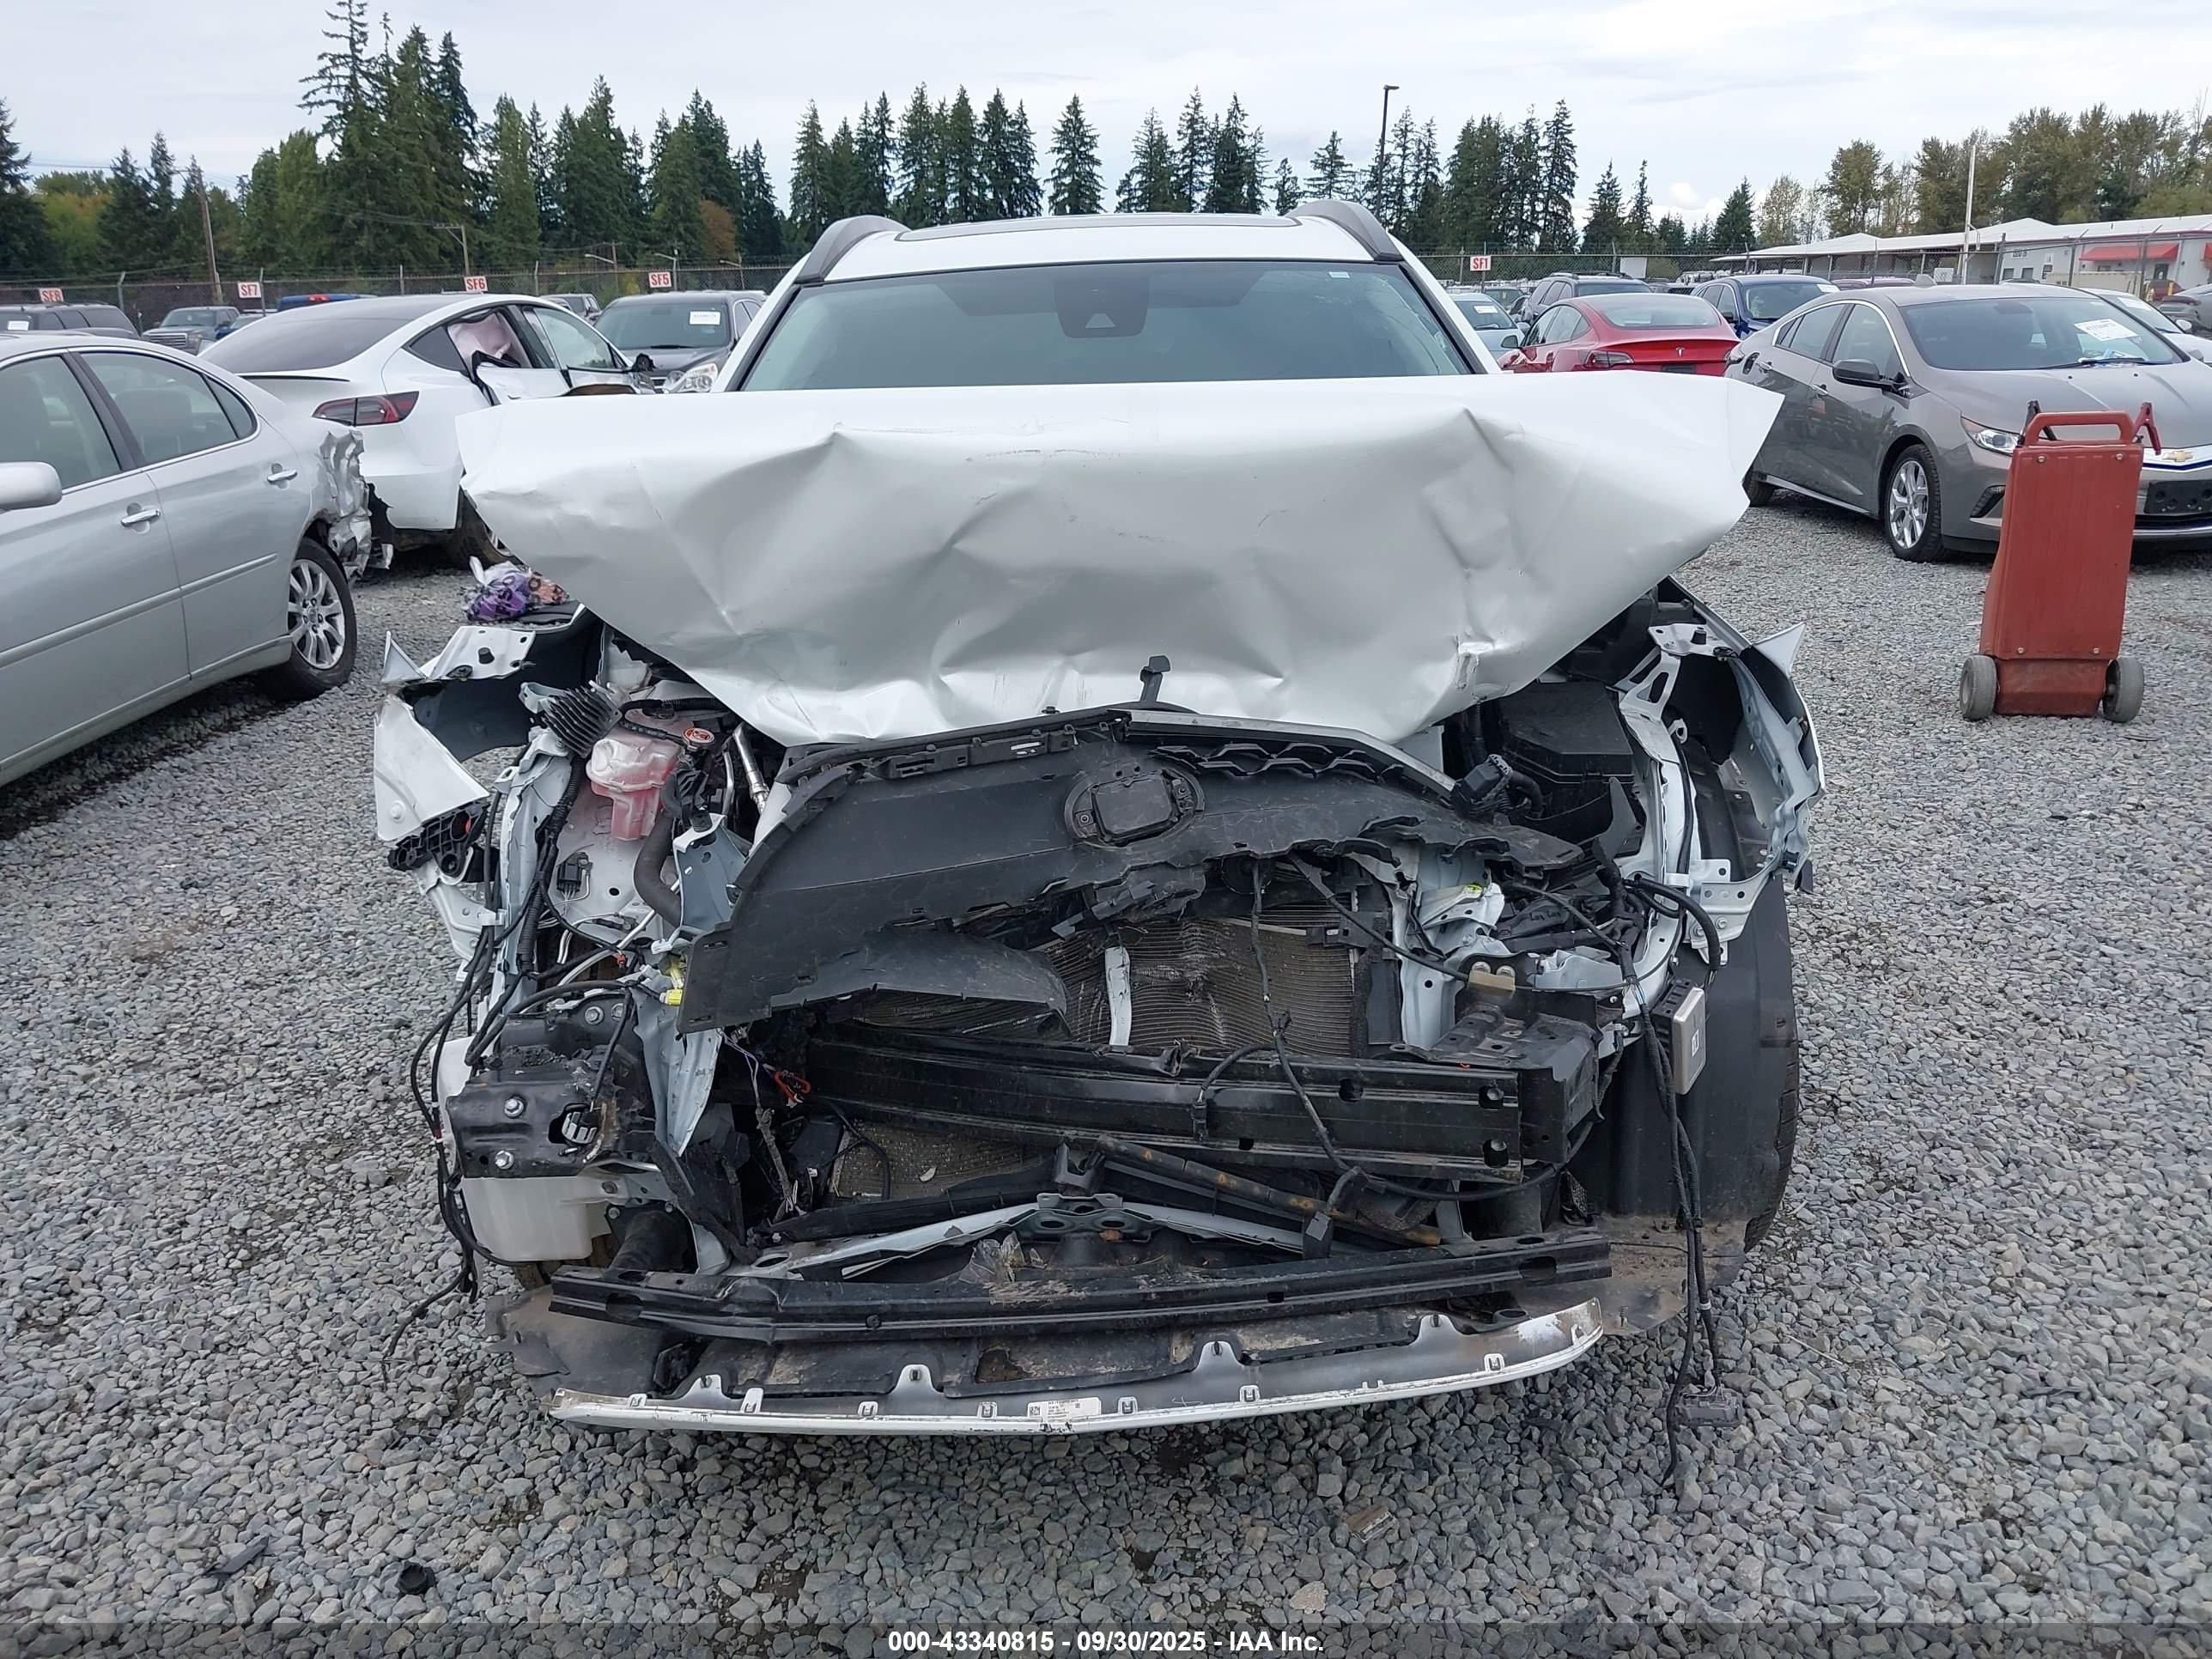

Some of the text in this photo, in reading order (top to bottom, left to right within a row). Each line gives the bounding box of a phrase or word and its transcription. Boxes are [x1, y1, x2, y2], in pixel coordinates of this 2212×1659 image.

[1473, 258, 1488, 270] SF1
[467, 278, 486, 290] SF6
[651, 274, 670, 286] SF5
[240, 284, 258, 296] SF7
